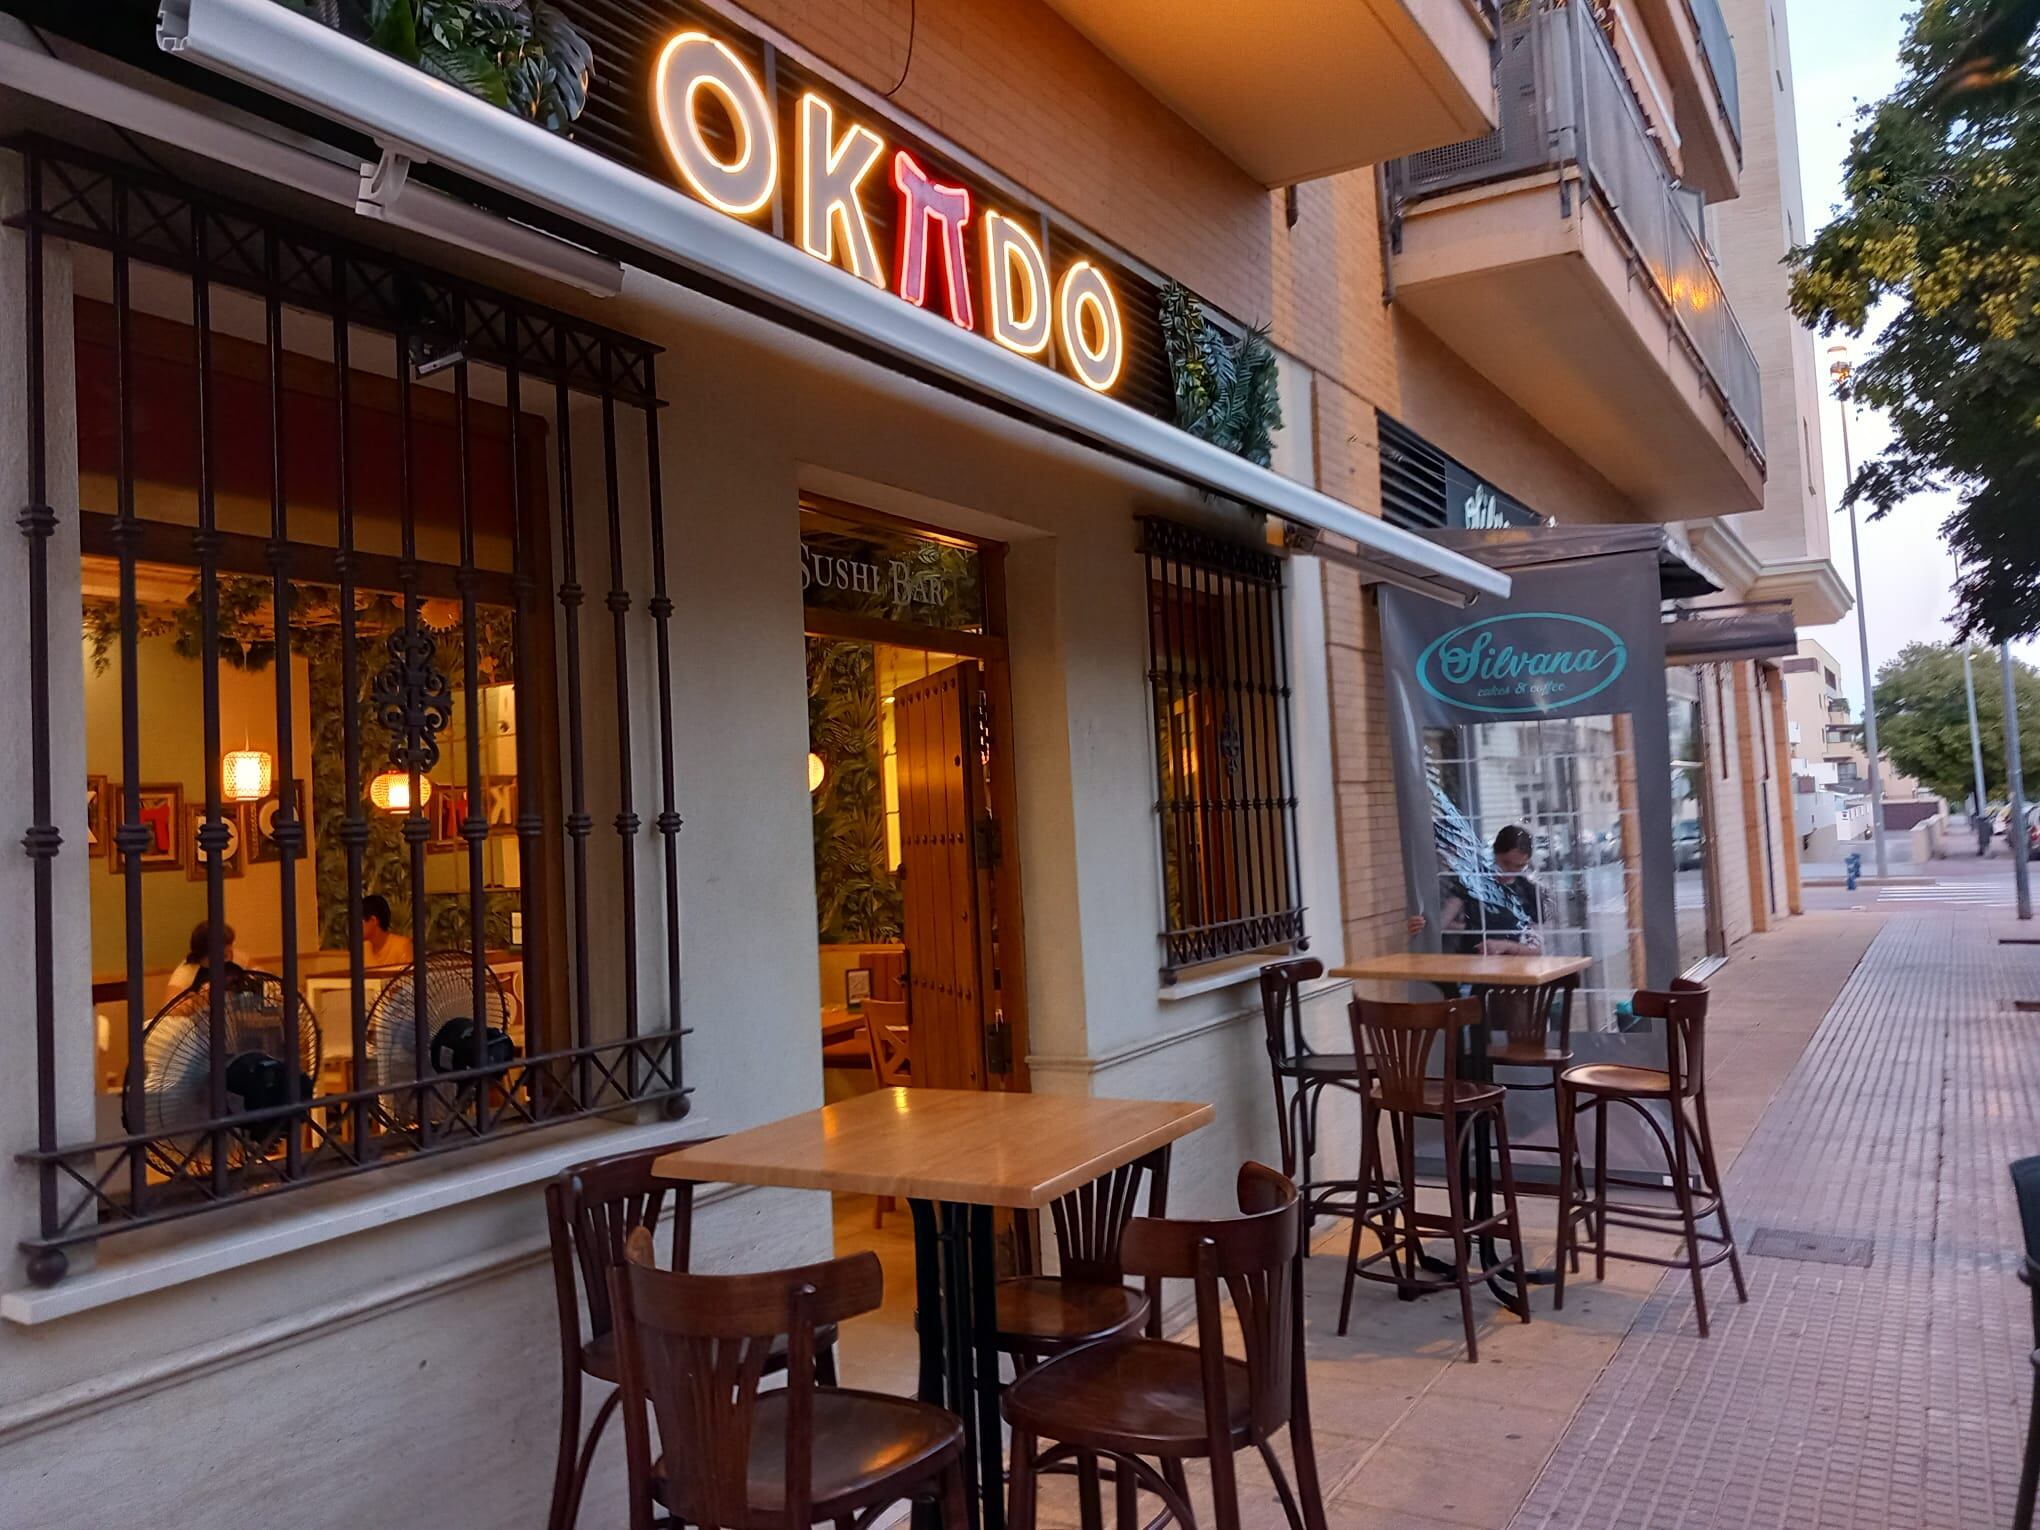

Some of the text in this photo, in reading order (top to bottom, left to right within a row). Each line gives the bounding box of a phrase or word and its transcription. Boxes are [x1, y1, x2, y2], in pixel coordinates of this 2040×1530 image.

[801, 542, 946, 608] SUSHI BAR
[1439, 631, 1614, 684] Silvana
[1514, 681, 1528, 695] &
[1530, 679, 1566, 697] coffee
